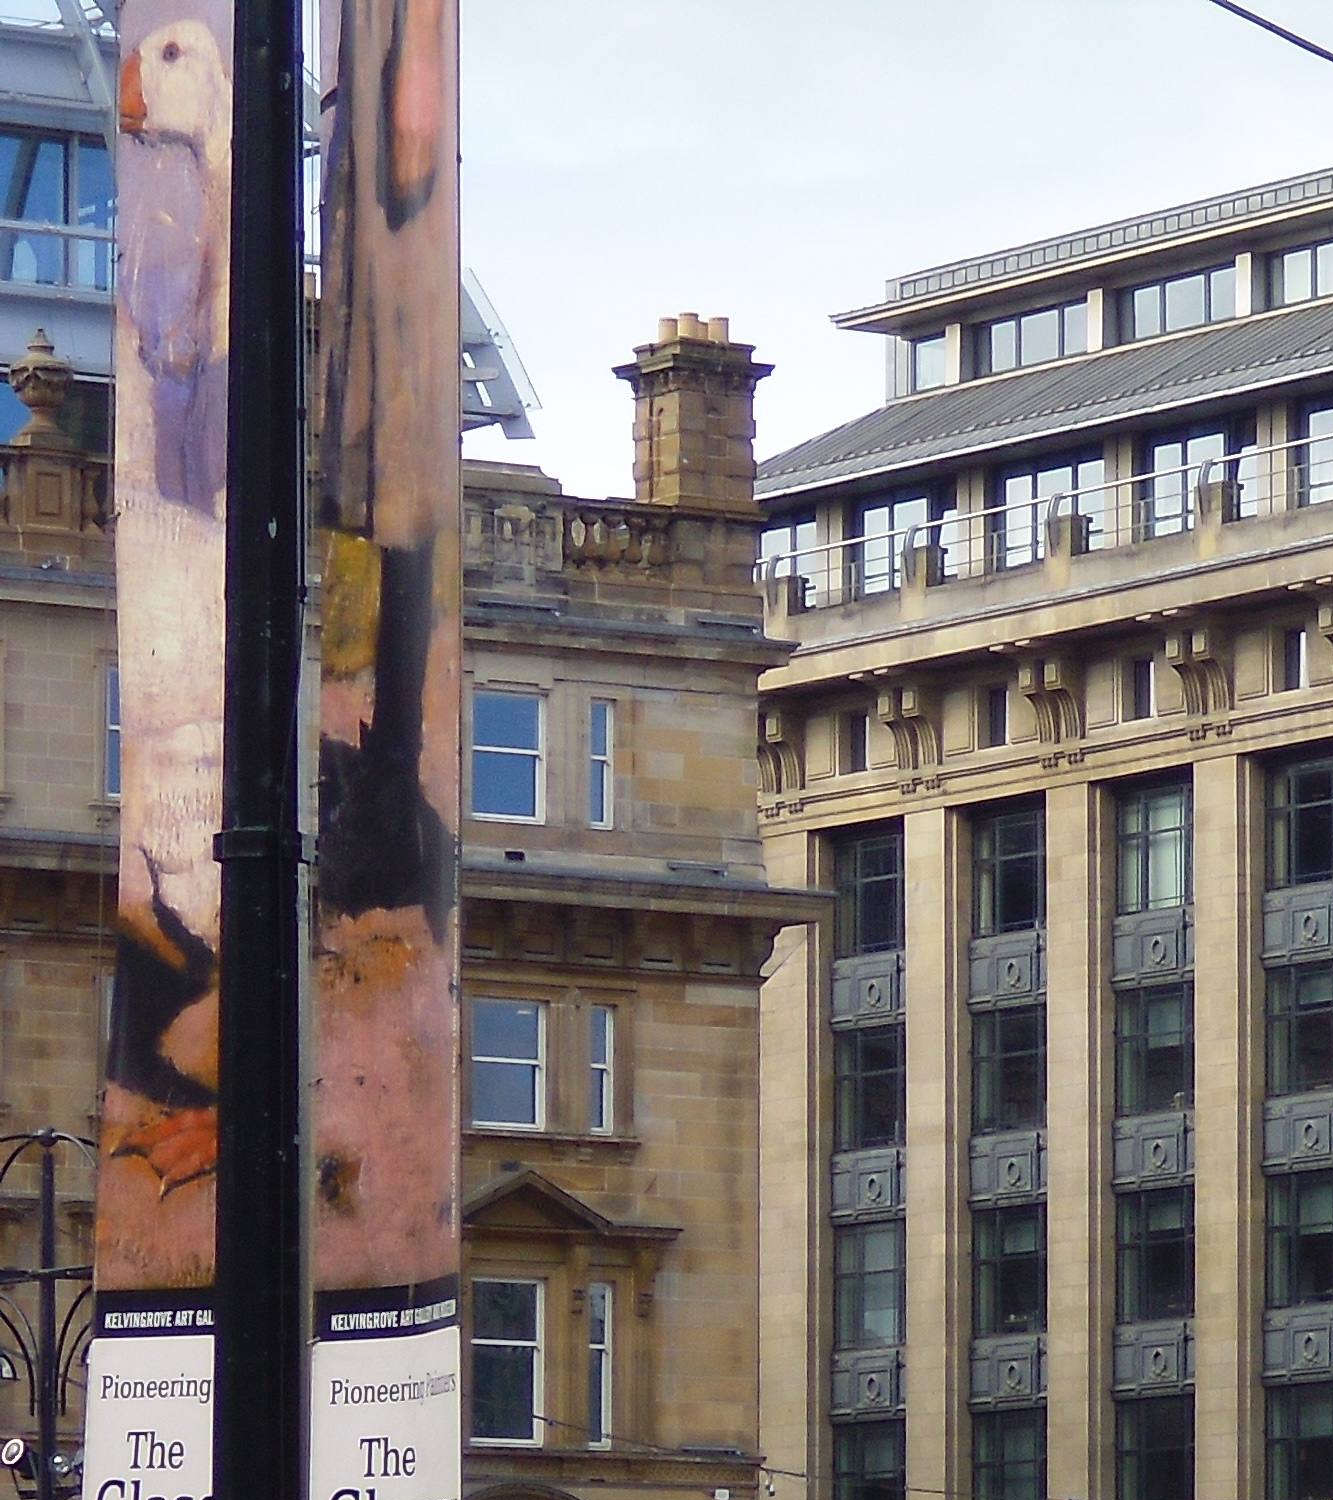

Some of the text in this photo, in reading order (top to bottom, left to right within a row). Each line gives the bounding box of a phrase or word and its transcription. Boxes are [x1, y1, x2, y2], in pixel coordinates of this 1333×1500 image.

[104, 1311, 173, 1328] KELVINGROVE
[174, 1310, 194, 1327] ART
[331, 1311, 399, 1331] KELVINGROVE
[101, 1373, 212, 1404] Pioneering
[330, 1377, 424, 1406] Pioneering
[127, 1431, 185, 1469] The
[360, 1437, 416, 1477] The
